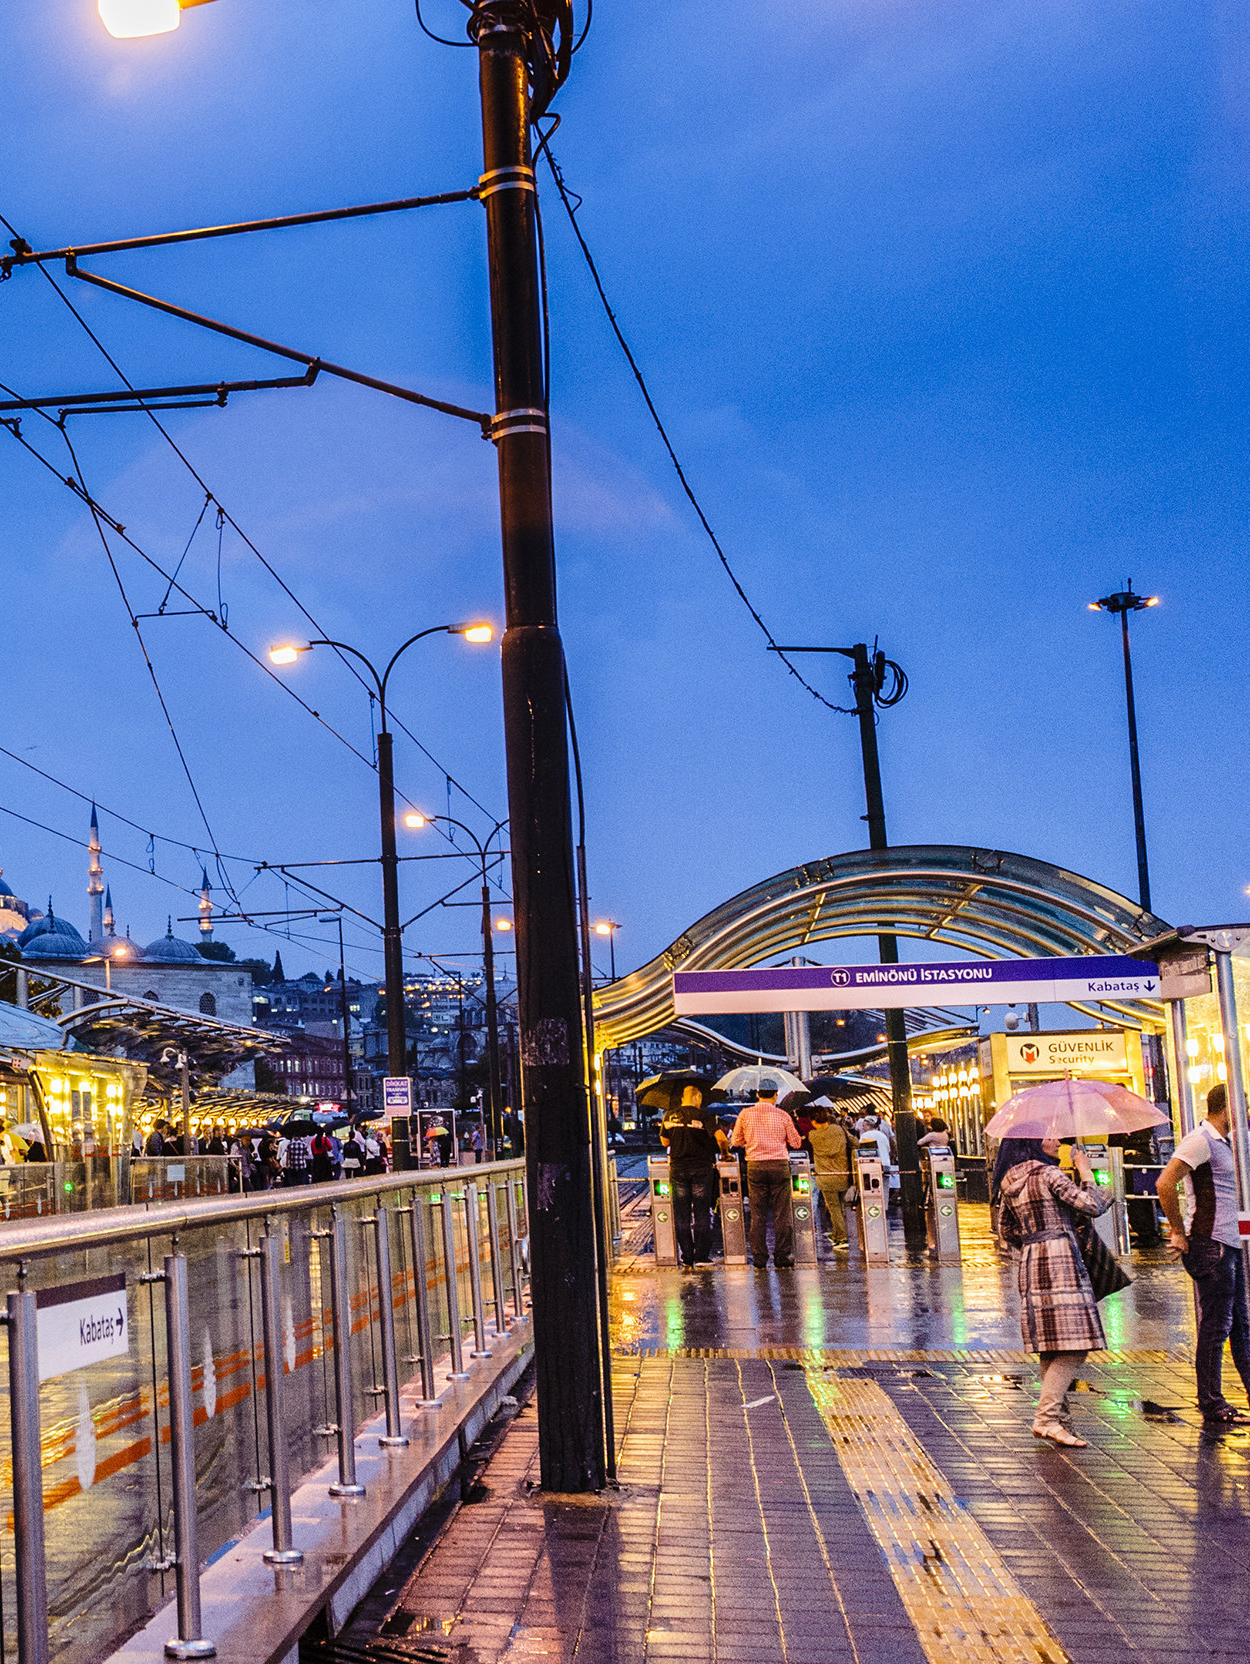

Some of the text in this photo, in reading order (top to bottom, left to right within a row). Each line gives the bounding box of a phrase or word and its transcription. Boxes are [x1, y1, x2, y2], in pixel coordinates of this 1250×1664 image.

[833, 968, 992, 983] T1 EMİNÖNÜ İSTASYONU
[1088, 982, 1140, 993] Kabataş
[1048, 1039, 1114, 1053] GÜVENLİK
[79, 1314, 114, 1346] Kabataş
